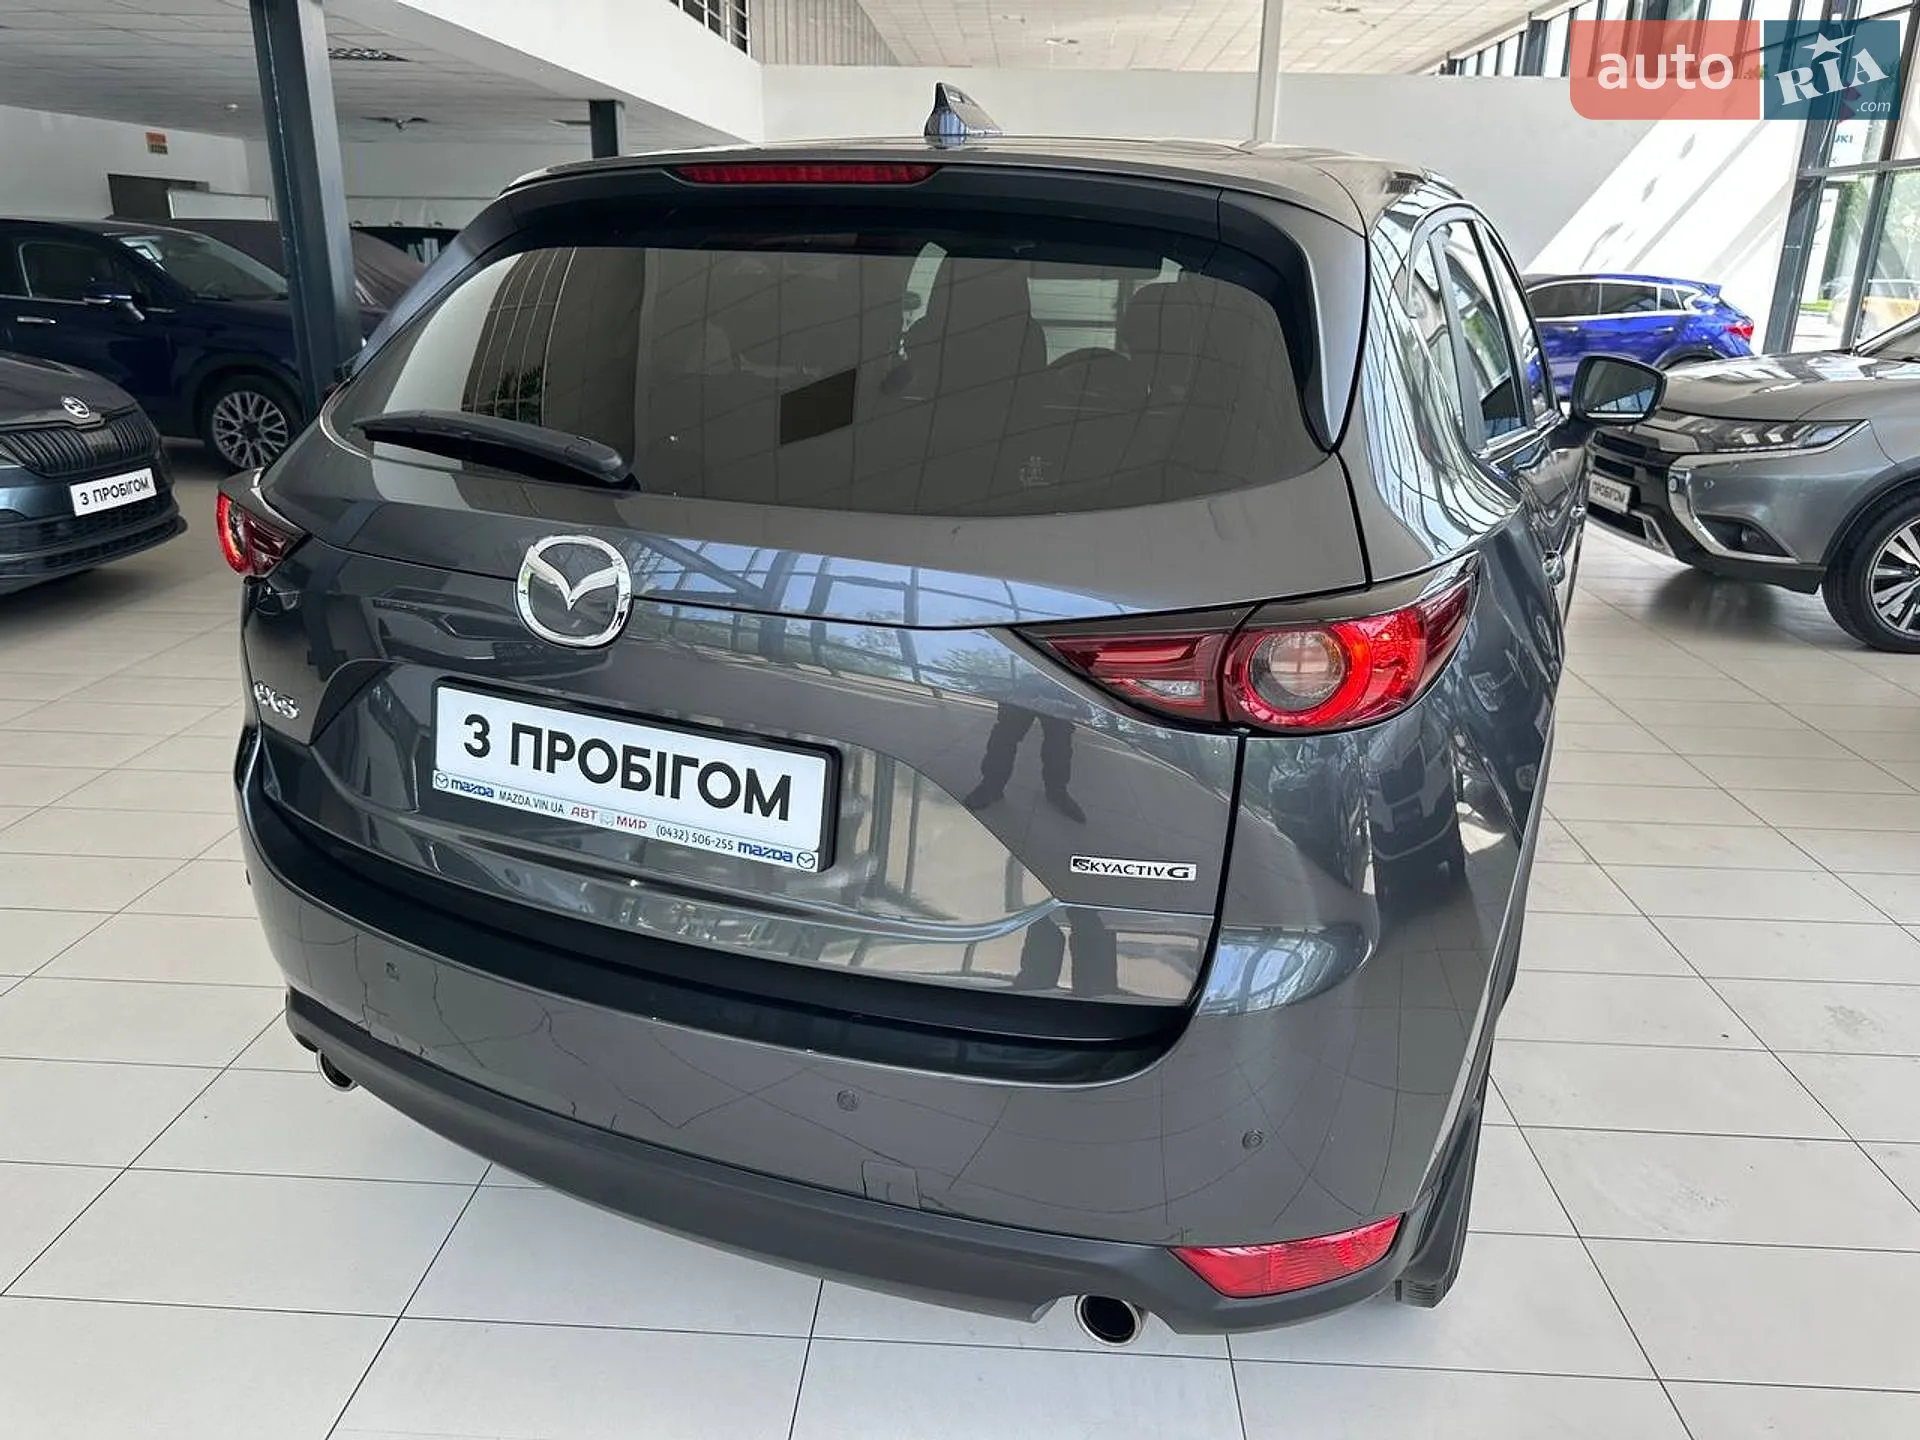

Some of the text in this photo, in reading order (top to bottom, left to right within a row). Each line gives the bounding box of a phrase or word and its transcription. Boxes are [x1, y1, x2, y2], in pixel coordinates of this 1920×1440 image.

[510, 721, 792, 821] ПРОБІГОМ
[451, 778, 495, 798] mazda
[655, 824, 734, 851] (0432) 506-255
[737, 841, 793, 863] mazda
